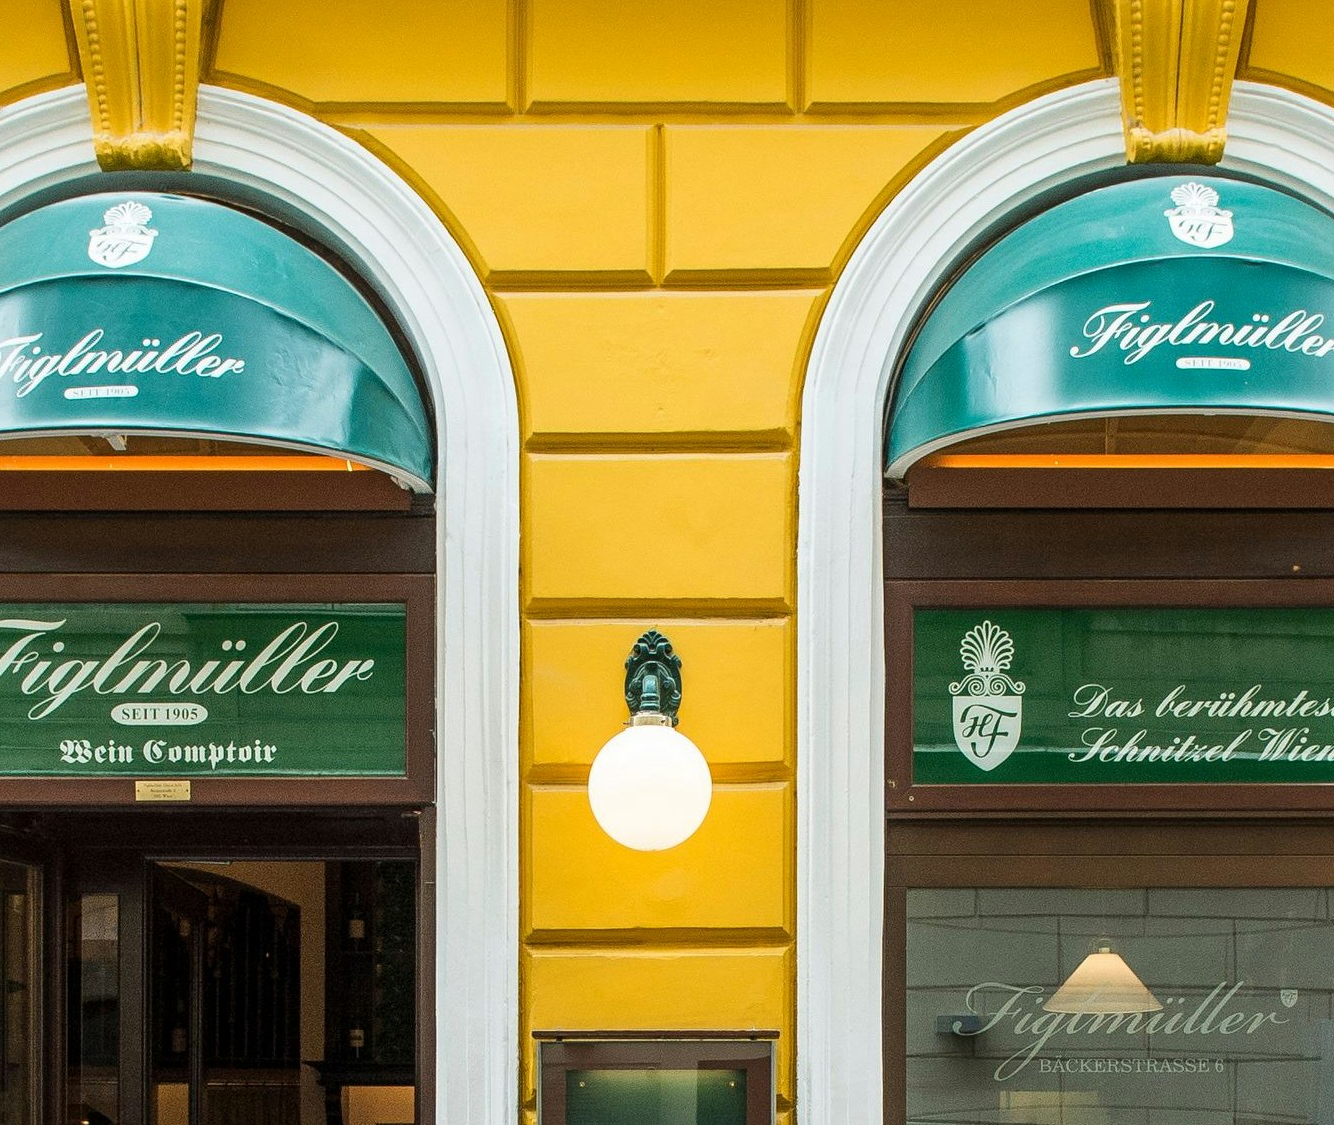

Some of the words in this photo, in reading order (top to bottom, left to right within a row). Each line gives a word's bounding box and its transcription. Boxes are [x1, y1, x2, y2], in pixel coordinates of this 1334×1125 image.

[121, 707, 161, 721] SEIT
[164, 707, 199, 721] 1905
[1067, 682, 1144, 719] Das
[59, 739, 134, 765] Wein
[142, 739, 278, 771] Comptoir
[1067, 726, 1251, 764] Schnitzel
[953, 980, 1290, 1082] Figlmüller
[1039, 1055, 1211, 1074] BÄCKERSTRASSE
[1214, 1058, 1225, 1074] 6
